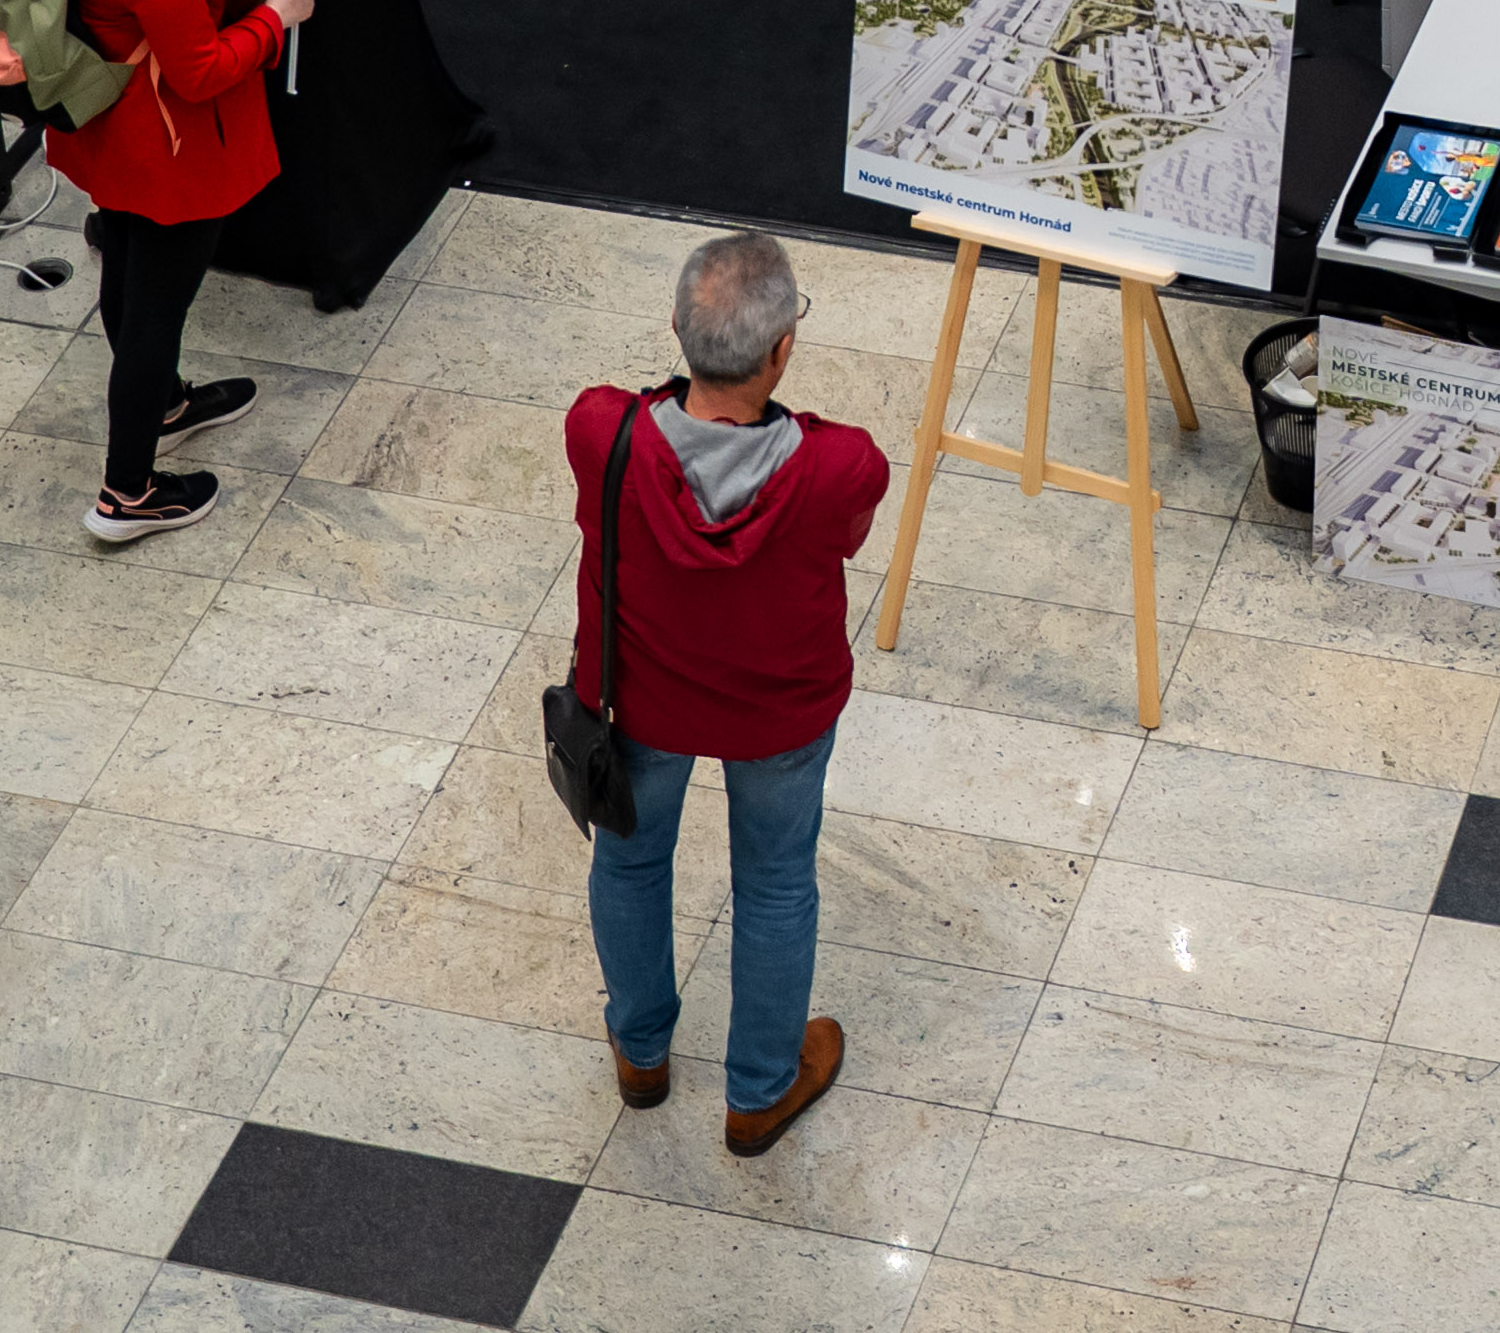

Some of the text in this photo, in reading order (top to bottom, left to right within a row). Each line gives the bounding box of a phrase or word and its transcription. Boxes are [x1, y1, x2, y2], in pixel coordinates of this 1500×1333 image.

[858, 169, 1072, 232] Nové mestské centrum Hornád
[1331, 344, 1379, 366] NOVÉ
[1331, 360, 1500, 404] MESTSKÉ CENTRUM
